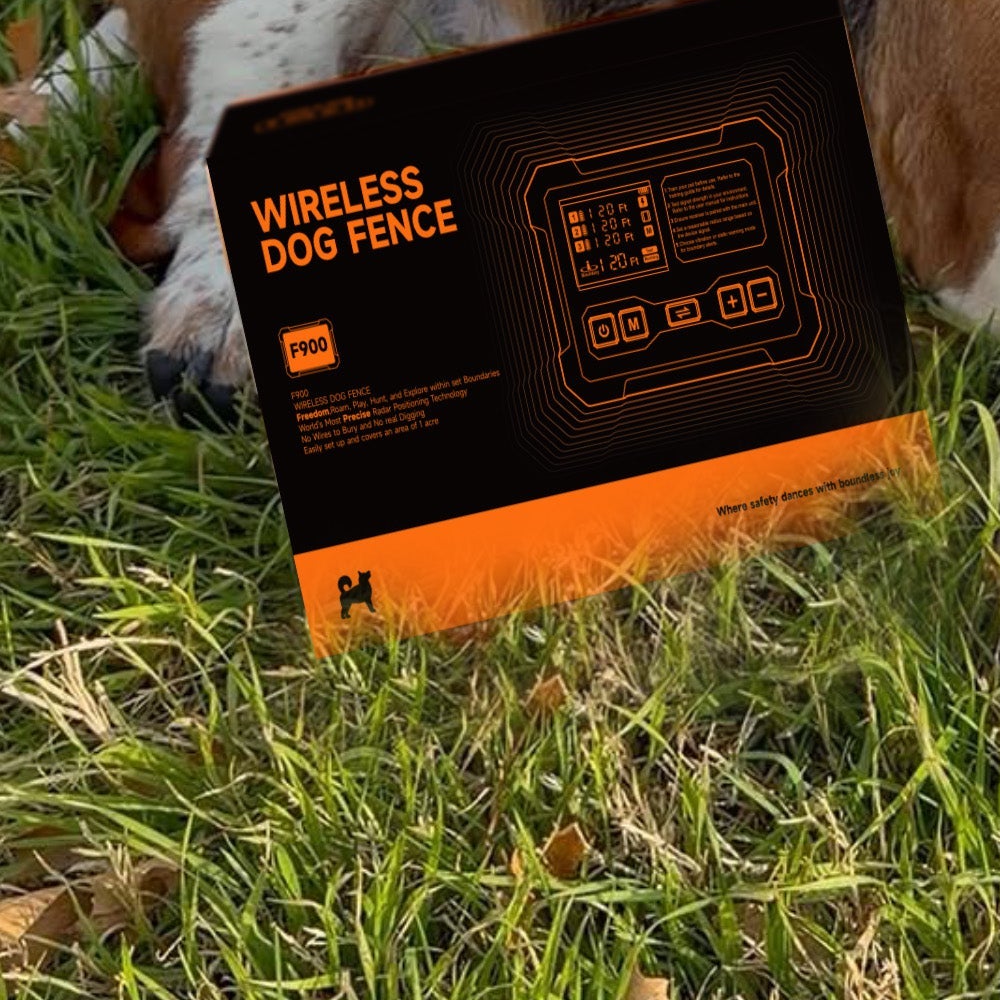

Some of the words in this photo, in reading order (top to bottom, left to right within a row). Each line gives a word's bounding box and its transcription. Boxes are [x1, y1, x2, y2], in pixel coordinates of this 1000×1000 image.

[250, 165, 424, 233] WIRELESS
[260, 226, 338, 274] DOG
[347, 198, 459, 254] FENCE
[627, 317, 640, 332] M
[289, 336, 328, 359] F900
[290, 388, 309, 400] F900
[293, 395, 329, 411] WIRELESS
[329, 391, 347, 403] DOG
[347, 385, 371, 399] FENCE
[389, 391, 403, 401] and
[403, 386, 429, 398] Explore
[429, 381, 450, 391] within
[451, 378, 462, 387] set
[462, 370, 501, 384] Boundaries
[298, 420, 324, 433] World's
[324, 417, 342, 427] Most
[342, 410, 371, 423] Precise
[372, 406, 392, 416] Radar
[393, 397, 430, 411] Positioning
[430, 389, 468, 403] Technology
[301, 435, 312, 443] No
[312, 431, 332, 441] Wires
[341, 425, 358, 435] Bury
[359, 420, 373, 431] and
[373, 419, 384, 427] No
[385, 414, 398, 425] real
[398, 409, 426, 422] Digging
[303, 444, 323, 455] Easily
[324, 441, 335, 450] set
[335, 439, 346, 448] up
[346, 434, 360, 445] and
[361, 431, 383, 442] covers
[384, 429, 393, 437] an
[394, 425, 409, 434] area
[410, 421, 418, 430] of
[419, 420, 423, 428] 1
[424, 418, 439, 427] acre
[716, 503, 748, 517] Where
[750, 494, 779, 509] safety
[781, 487, 814, 502] dances
[816, 480, 837, 494] with
[838, 471, 885, 489] boundless
